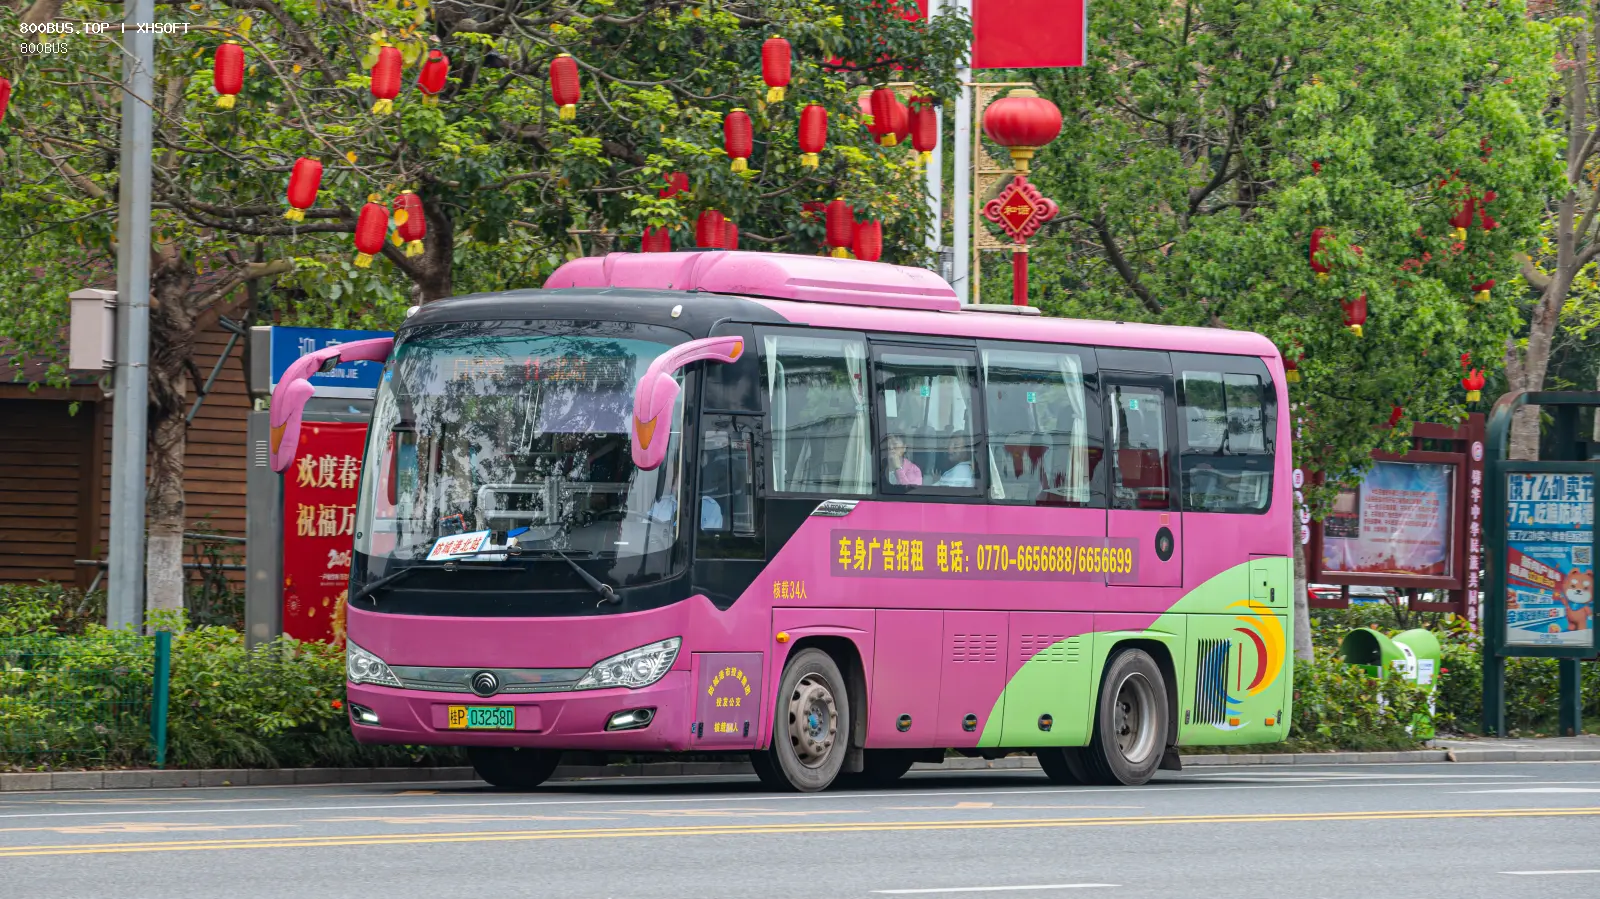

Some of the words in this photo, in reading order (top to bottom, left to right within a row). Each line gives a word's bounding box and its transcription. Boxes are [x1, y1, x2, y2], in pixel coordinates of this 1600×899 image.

[1004, 205, 1031, 215] 和谐
[296, 454, 362, 489] 欢度春
[431, 536, 482, 557] 防城港北站
[838, 536, 924, 572] 车身广告招租
[773, 580, 807, 599] 核载34人
